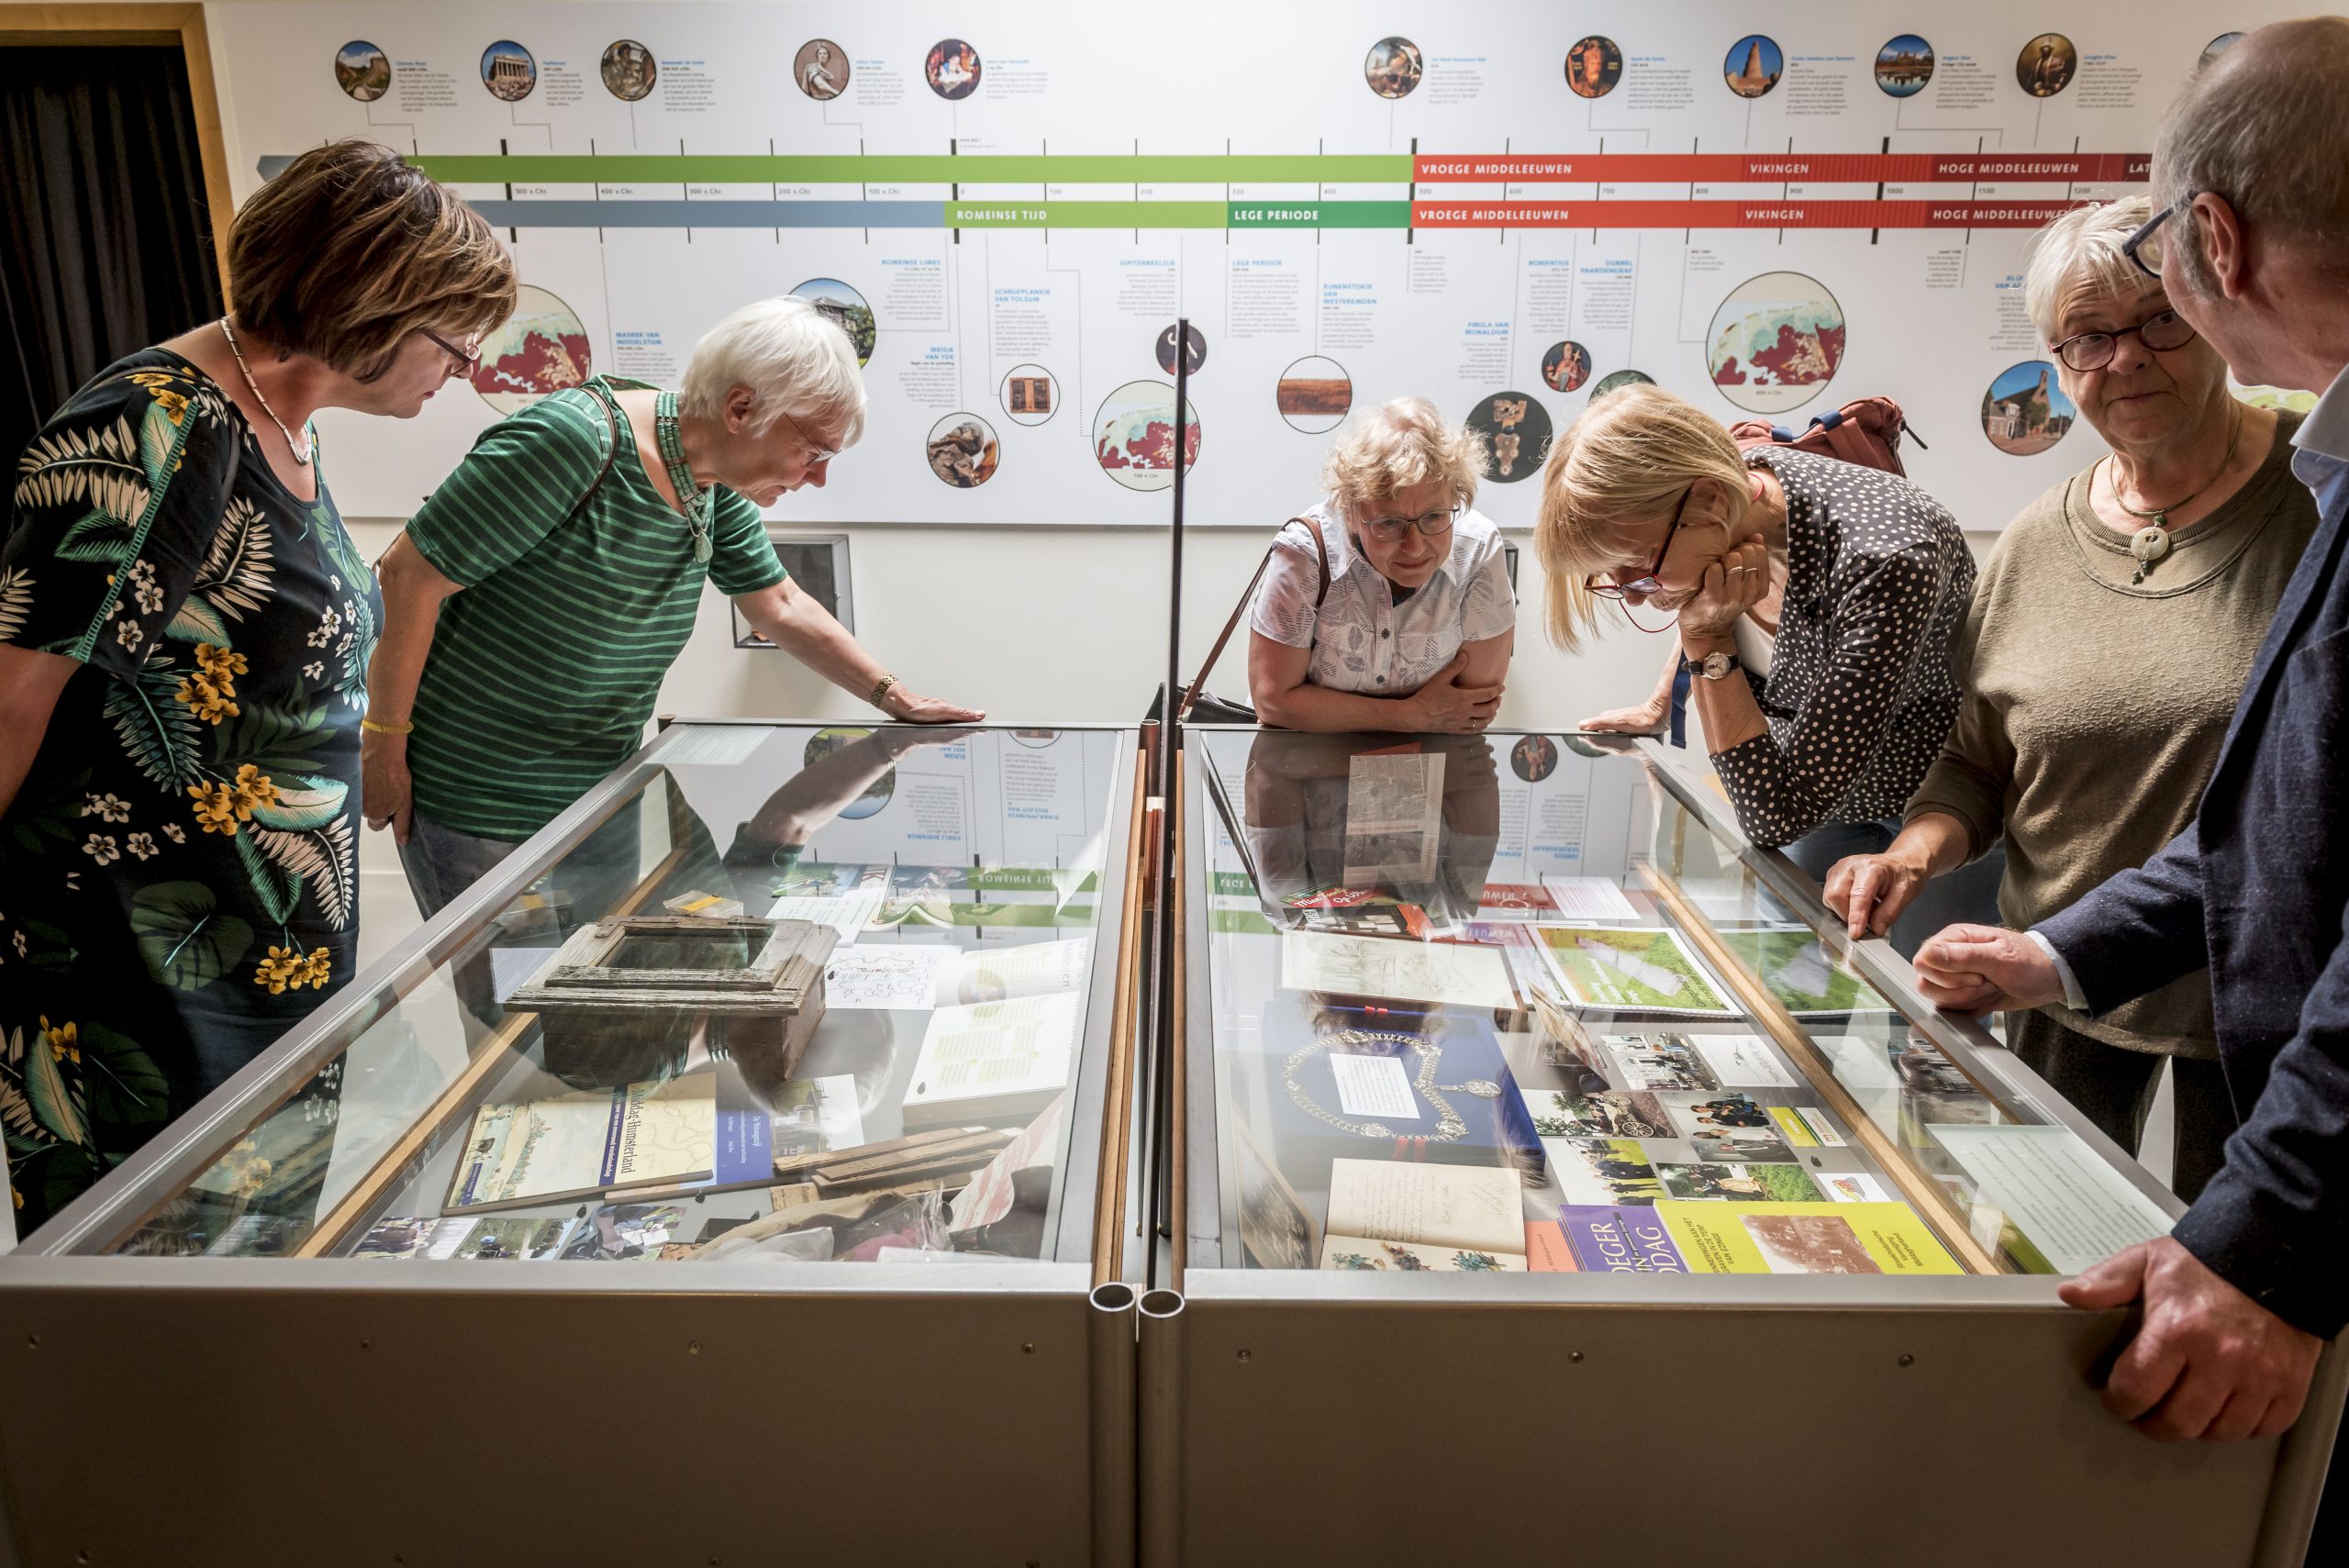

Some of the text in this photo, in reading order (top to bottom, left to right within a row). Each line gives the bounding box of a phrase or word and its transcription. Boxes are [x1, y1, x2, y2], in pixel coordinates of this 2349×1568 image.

[1420, 163, 1573, 174] VROEGE MIDDELEEUWEN
[1749, 163, 1809, 174] VIKINGEN
[1939, 163, 2079, 174] HOGE MIDDELEEUWEN
[2129, 163, 2151, 174] LAT
[957, 210, 1048, 220] ROMEINSE TIJD
[1234, 210, 1319, 220] LEGE PERIODE
[1419, 210, 1569, 220] VROEGE MIDDELEEUWEN
[1745, 209, 1805, 220] VIKINGEN
[1932, 209, 2069, 220] HOGE MIDDELEEUWE
[1683, 1217, 1692, 1228] HET
[1688, 1228, 1699, 1240] AAN
[1696, 1224, 1708, 1237] TERP
[1711, 1232, 1734, 1264] VAN EZINGE
[1635, 1257, 1650, 1273] IN
